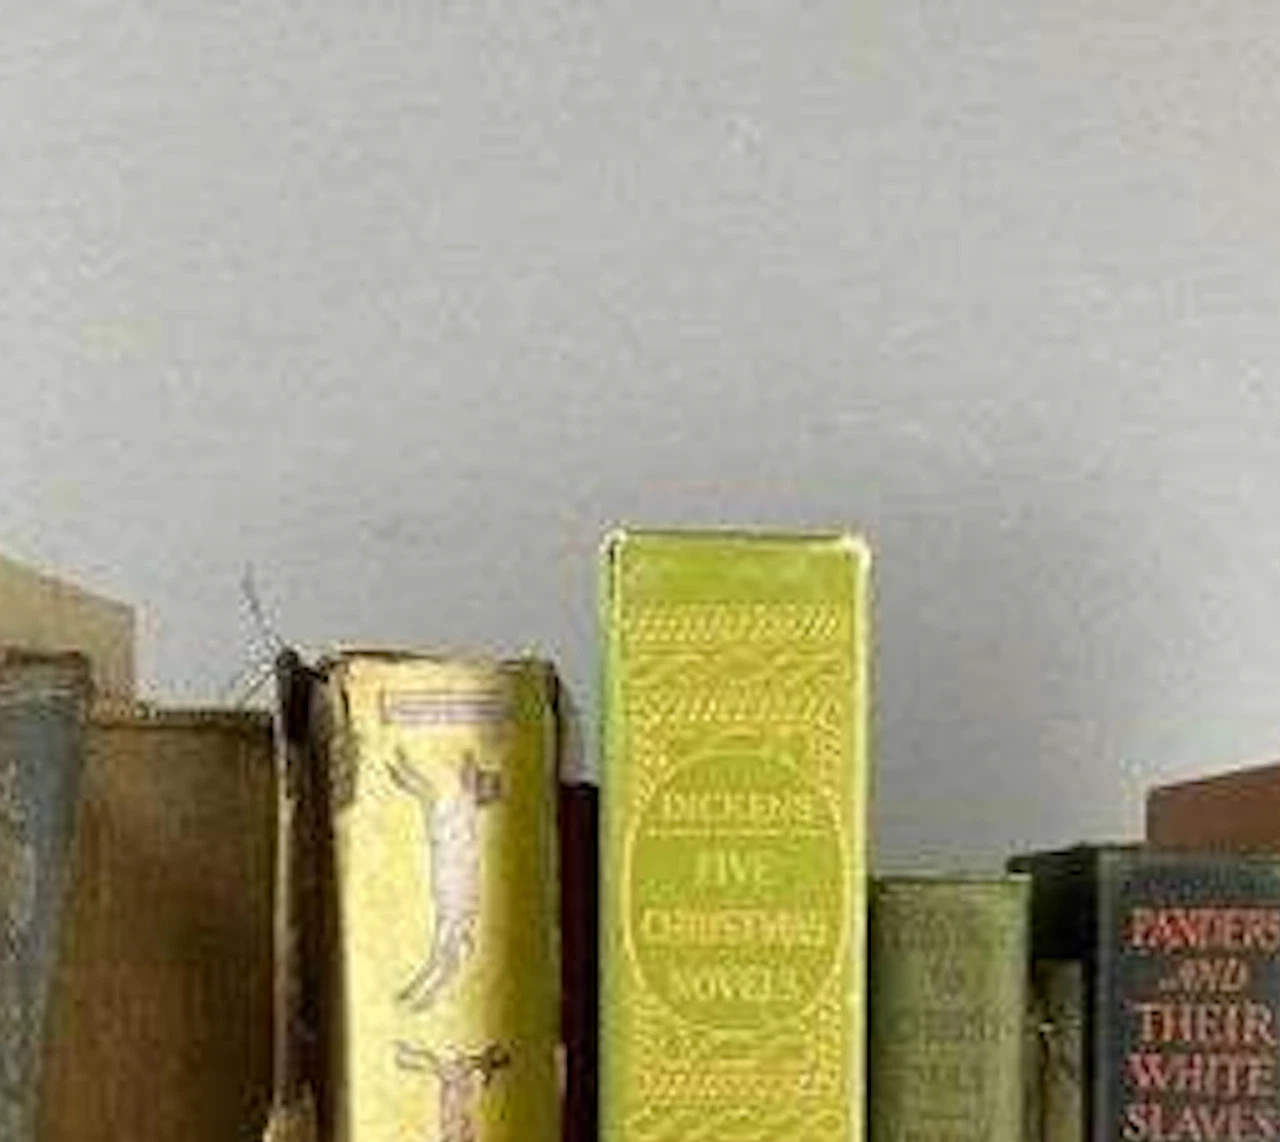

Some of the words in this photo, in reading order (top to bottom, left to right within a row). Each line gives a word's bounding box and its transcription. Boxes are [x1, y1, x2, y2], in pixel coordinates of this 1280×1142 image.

[662, 791, 814, 820] DICKENS
[694, 850, 771, 887] FIVE
[640, 908, 826, 945] CHRISTMAS
[671, 964, 804, 1002] NOVELS
[1159, 958, 1250, 993] AND
[1134, 1001, 1277, 1046] THEIR
[1126, 1052, 1277, 1097] WHITE
